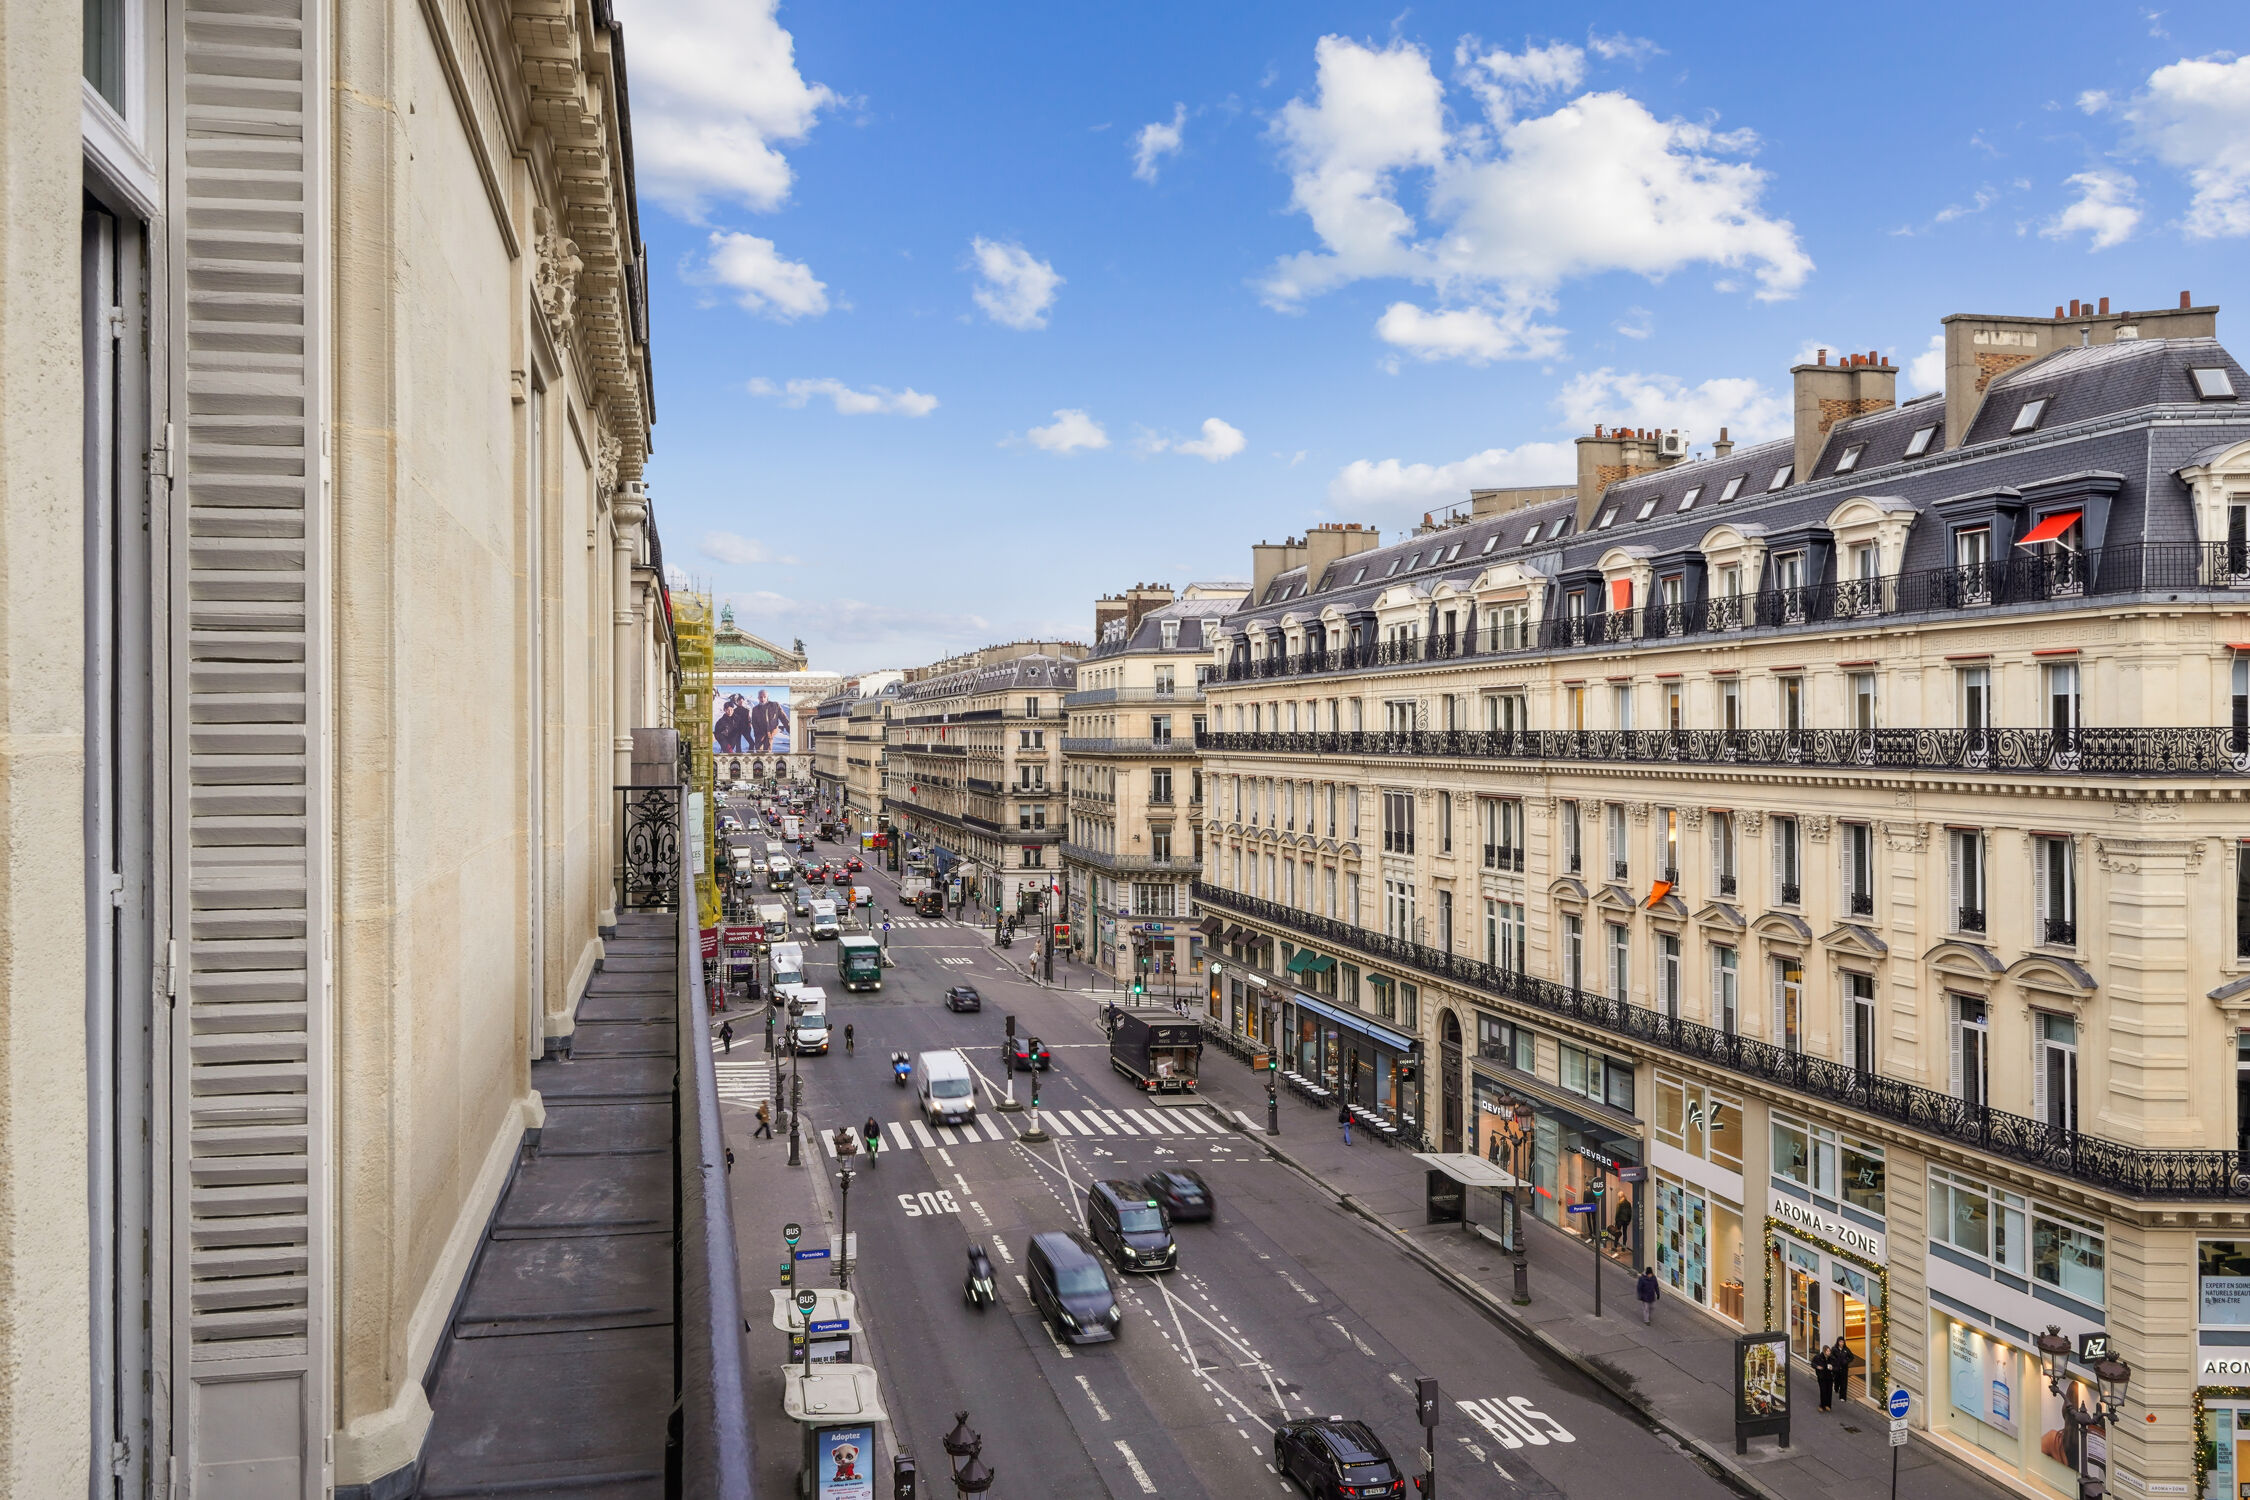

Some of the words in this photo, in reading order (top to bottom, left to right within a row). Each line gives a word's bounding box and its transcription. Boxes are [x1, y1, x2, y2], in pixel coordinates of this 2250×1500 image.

[897, 1190, 961, 1217] BUS
[786, 1228, 799, 1236] BUS
[1774, 1199, 1823, 1232] AROMA
[1838, 1225, 1878, 1256] ZONE
[800, 1295, 814, 1304] BUS
[2085, 1339, 2105, 1355] AZ
[1455, 1396, 1576, 1449] BUS
[832, 1433, 860, 1441] Adoptez
